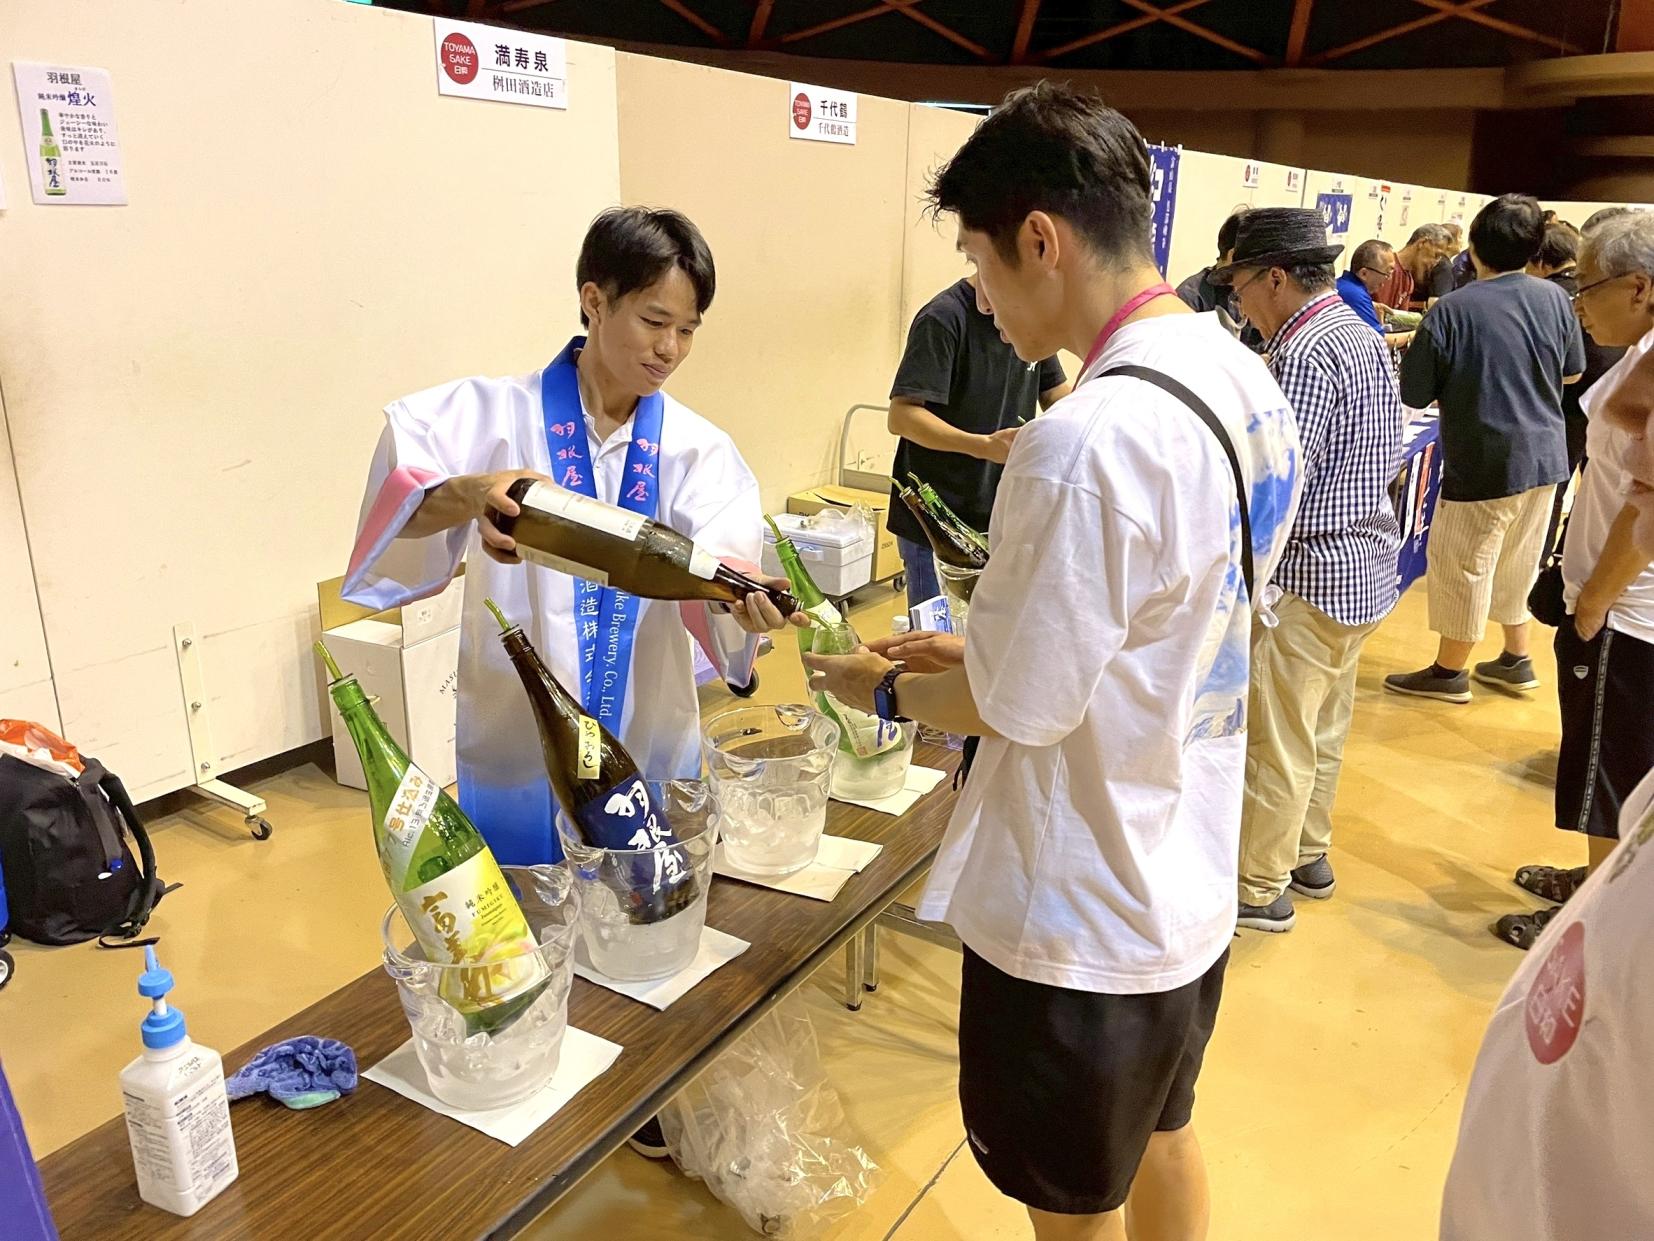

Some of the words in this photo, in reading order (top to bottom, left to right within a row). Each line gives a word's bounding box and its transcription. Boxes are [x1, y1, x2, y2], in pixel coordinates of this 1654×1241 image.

[443, 42, 475, 55] TOYAMA
[494, 43, 549, 72] 満寿泉
[449, 54, 472, 65] SAKE
[47, 72, 82, 86] 羽根屋
[492, 74, 554, 98] 桝田酒造店
[599, 695, 615, 718] Ltd.
